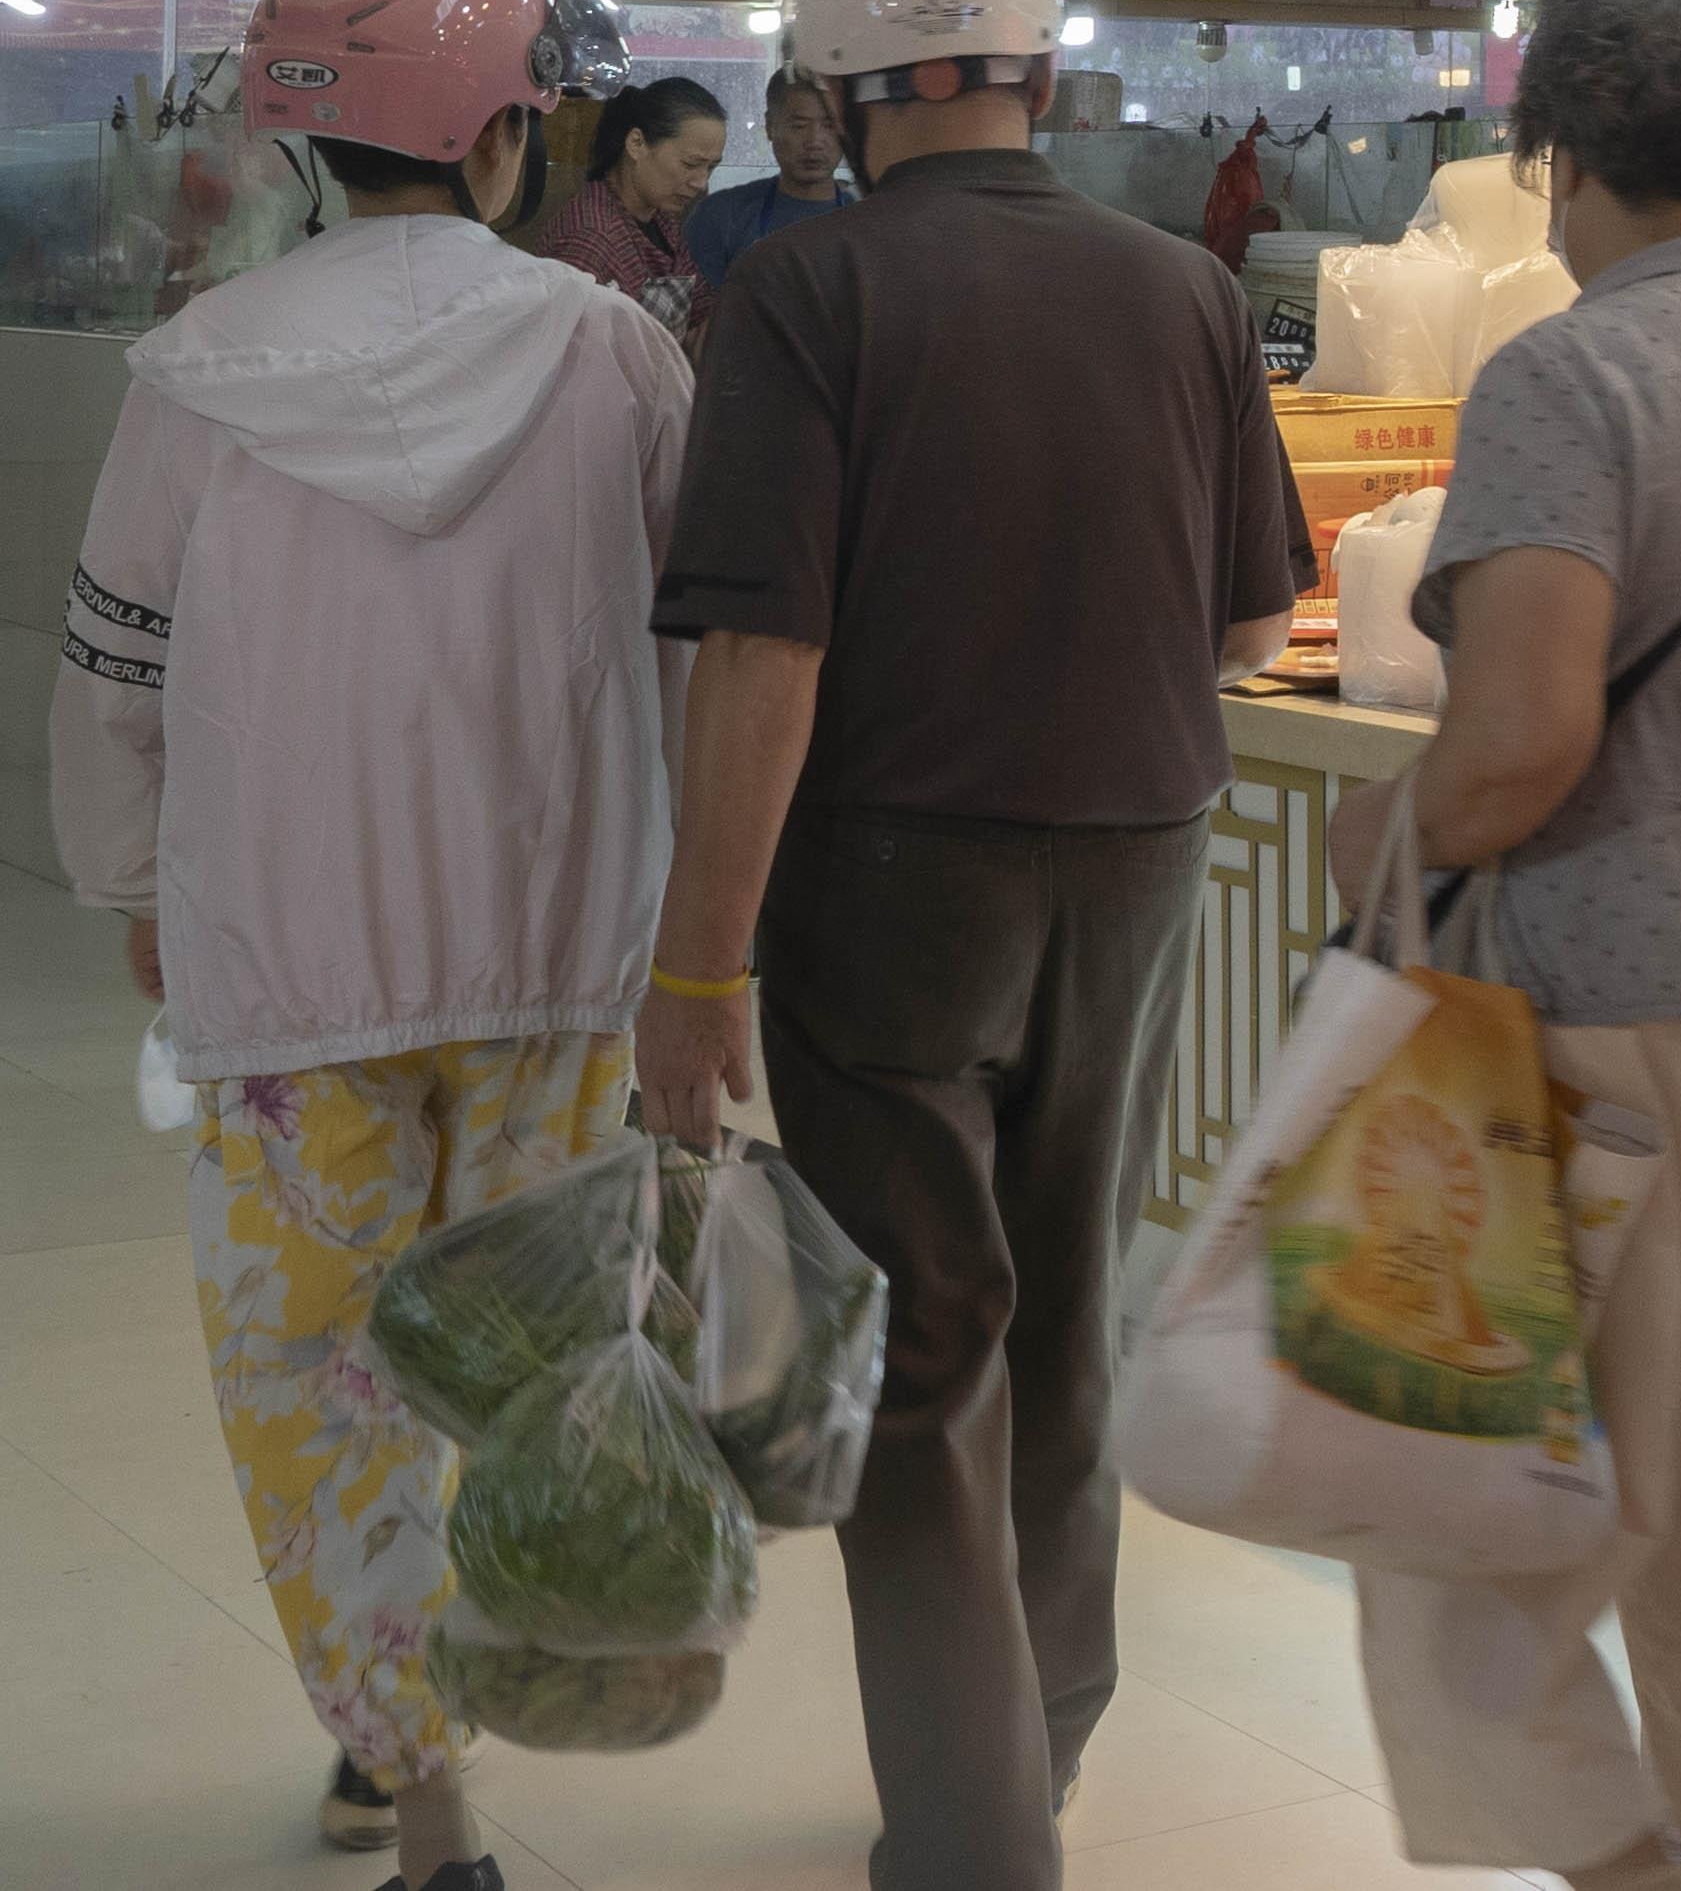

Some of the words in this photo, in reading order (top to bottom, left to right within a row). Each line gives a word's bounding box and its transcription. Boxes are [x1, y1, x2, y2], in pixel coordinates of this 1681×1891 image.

[1354, 424, 1437, 452] 绿色健康
[94, 655, 166, 687] MERLIN
